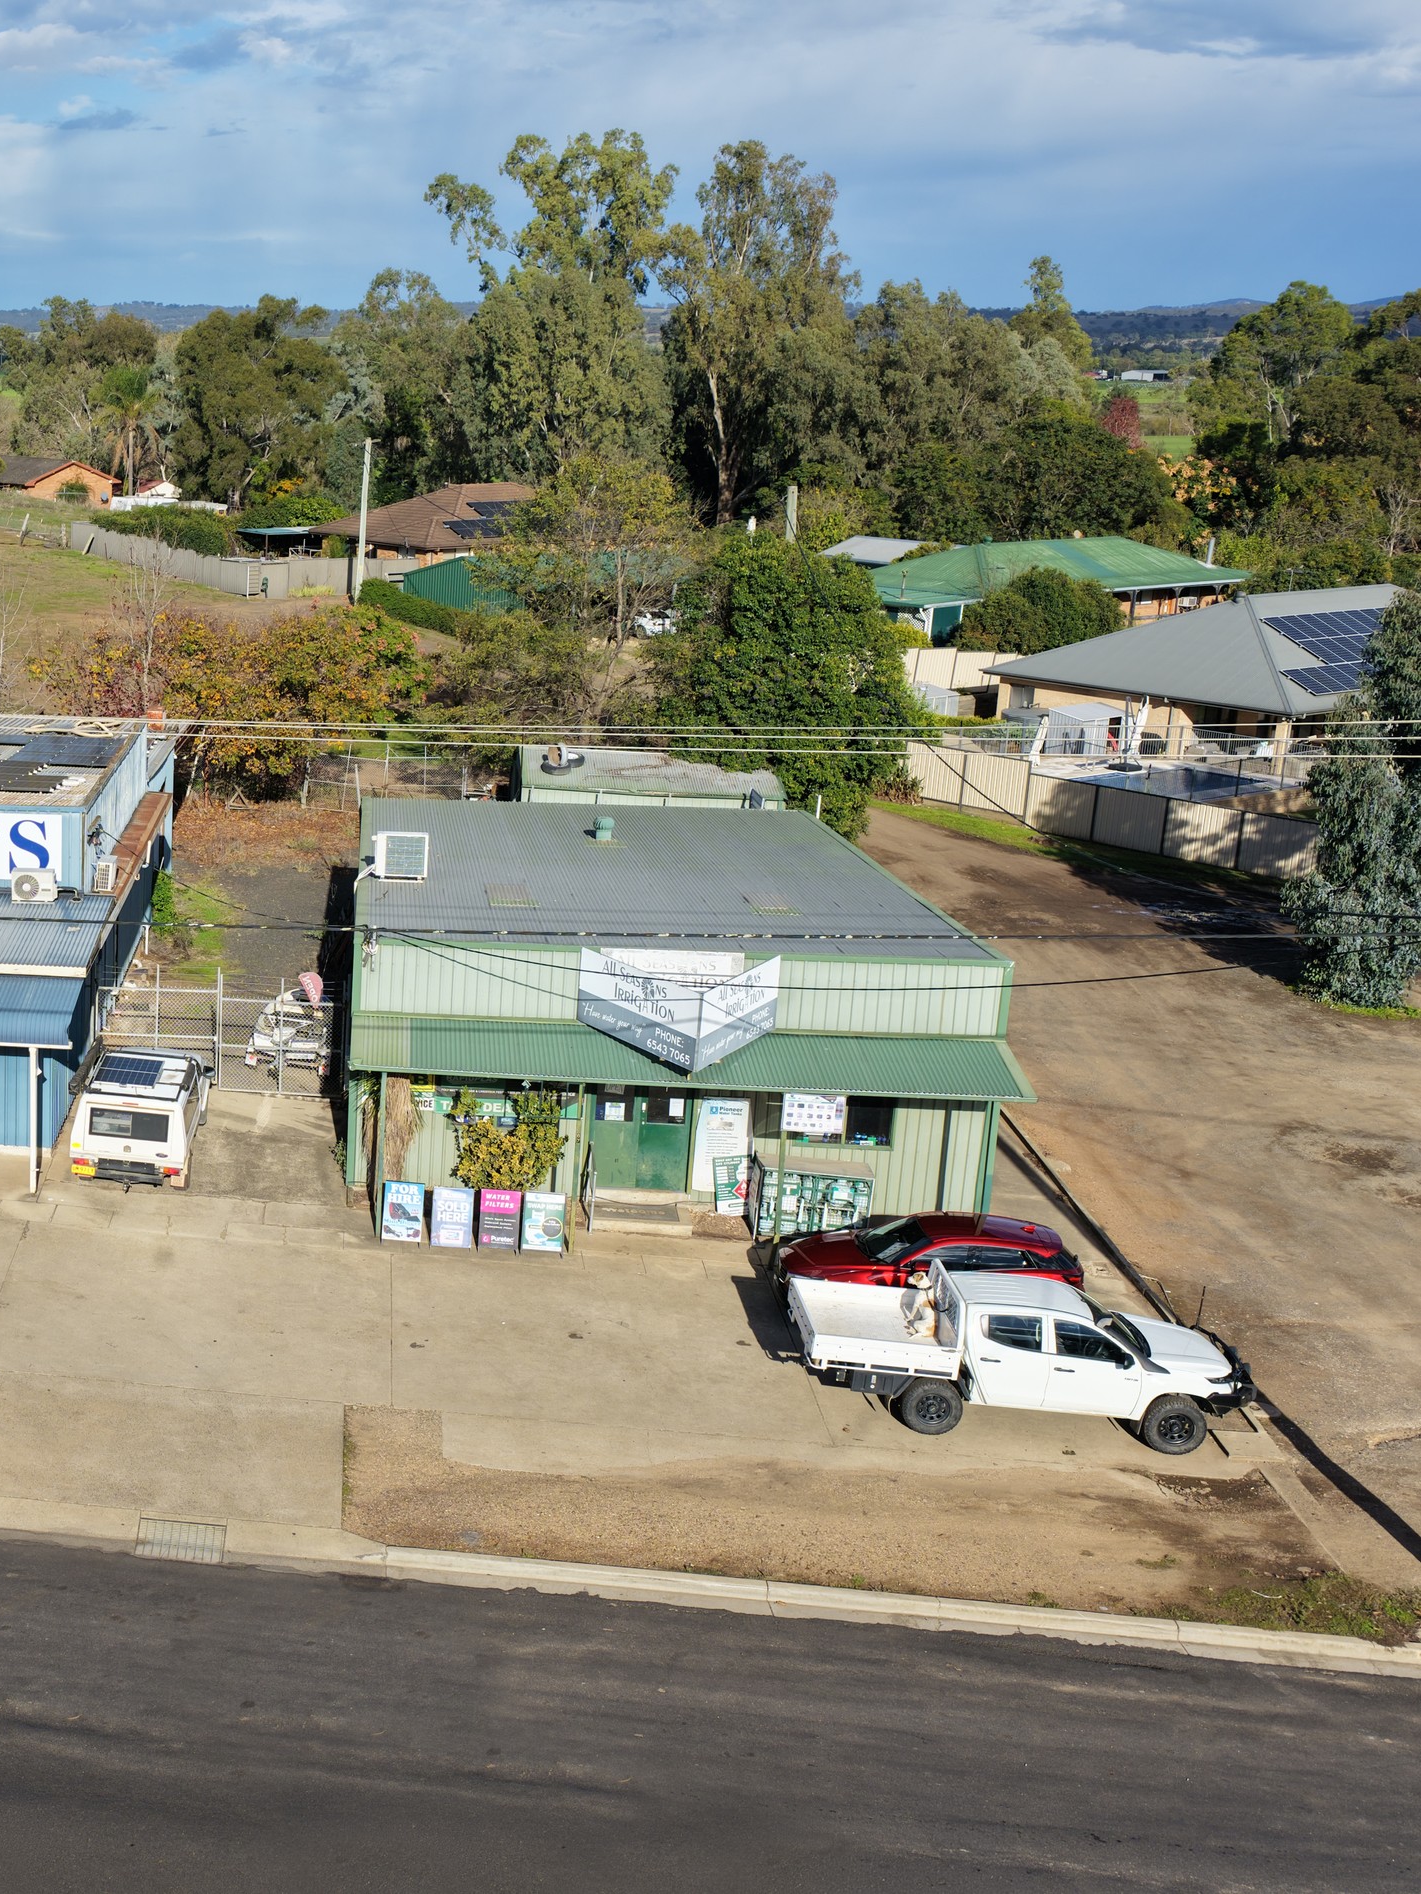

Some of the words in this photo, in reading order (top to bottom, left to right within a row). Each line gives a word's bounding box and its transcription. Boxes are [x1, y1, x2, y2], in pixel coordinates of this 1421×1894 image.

[654, 1027, 684, 1049] PHONE:
[746, 1024, 760, 1041] 6543
[646, 1038, 667, 1055] 6543
[669, 1047, 691, 1065] 7065
[391, 1184, 419, 1195] FOR
[387, 1193, 421, 1205] HIRE
[485, 1193, 511, 1201] WATER
[437, 1200, 469, 1212] SOLD
[484, 1201, 514, 1209] FILTERS
[527, 1202, 546, 1210] SWAP
[437, 1211, 469, 1223] HERE
